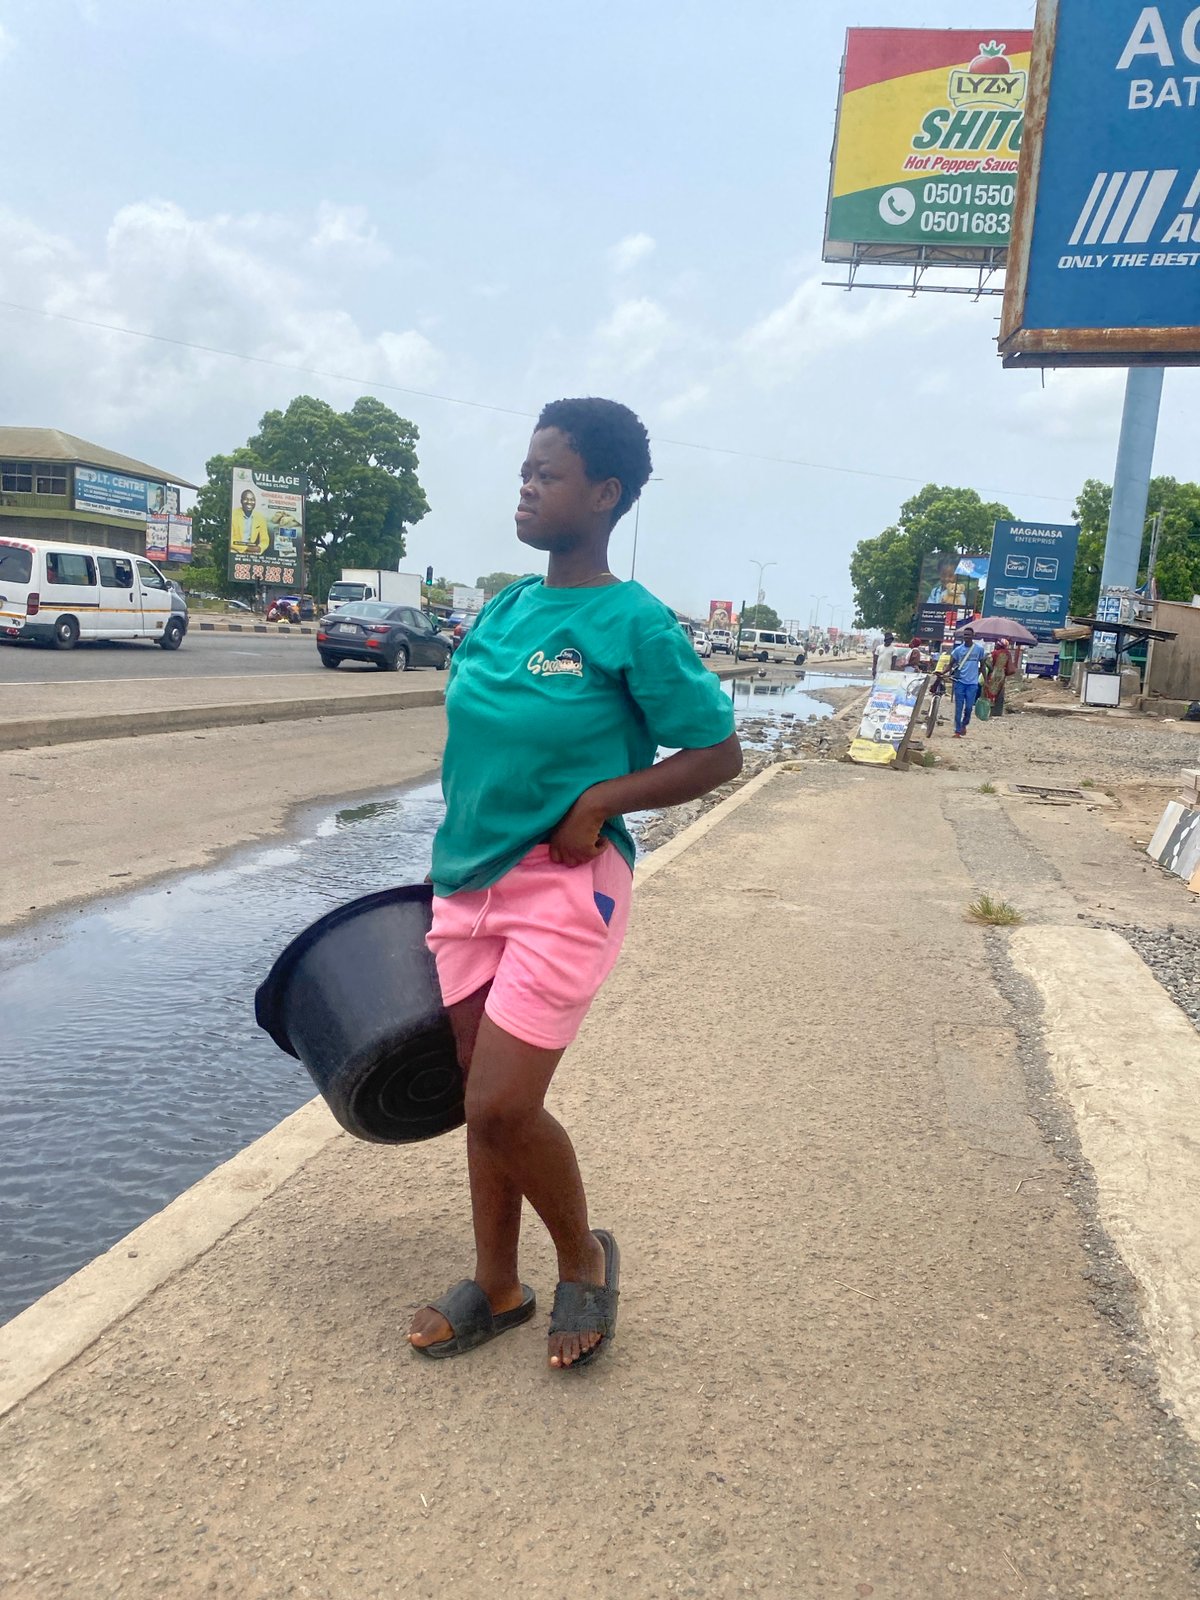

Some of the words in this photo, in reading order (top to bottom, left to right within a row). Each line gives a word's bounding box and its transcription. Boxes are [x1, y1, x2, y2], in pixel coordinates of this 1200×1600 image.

[957, 77, 1020, 94] LYZY
[1128, 76, 1200, 110] BAT
[904, 155, 930, 170] Hot
[931, 157, 981, 173] Pepper
[982, 158, 1019, 172] Sauc
[923, 183, 1017, 206] 0501550
[1057, 255, 1108, 269] ONLY
[1112, 253, 1149, 267] THE
[1150, 252, 1200, 267] BEST
[112, 477, 145, 493] CENTRE
[254, 472, 300, 486] VILLAGE
[1010, 527, 1063, 538] MAGANASA
[1015, 536, 1056, 545] ENTERPRISE
